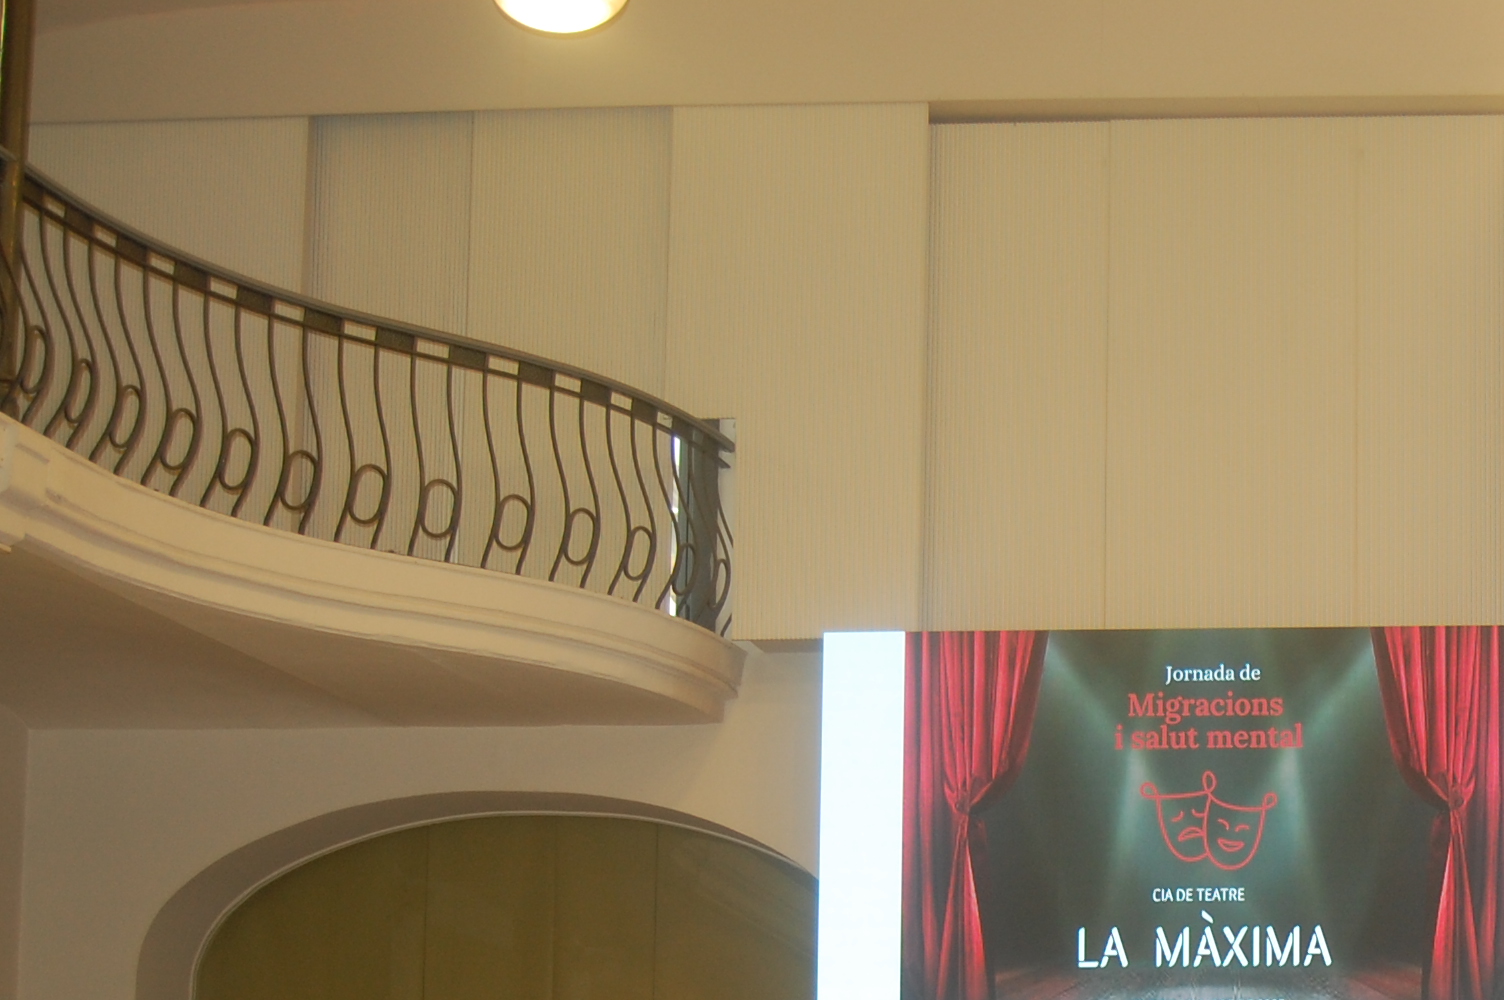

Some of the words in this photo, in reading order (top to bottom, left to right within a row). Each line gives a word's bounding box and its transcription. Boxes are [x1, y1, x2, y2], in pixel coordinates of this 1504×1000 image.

[1165, 663, 1235, 686] Jornada
[1239, 663, 1261, 681] de
[1127, 691, 1284, 725] Migracions
[1114, 724, 1124, 750] i
[1131, 724, 1199, 750] salut
[1206, 722, 1304, 748] mental
[1152, 888, 1174, 902] CIA
[1176, 888, 1193, 902] DE
[1196, 887, 1245, 902] TEATRE
[1077, 926, 1129, 968] LA
[1155, 910, 1333, 968] MÀXIMA
